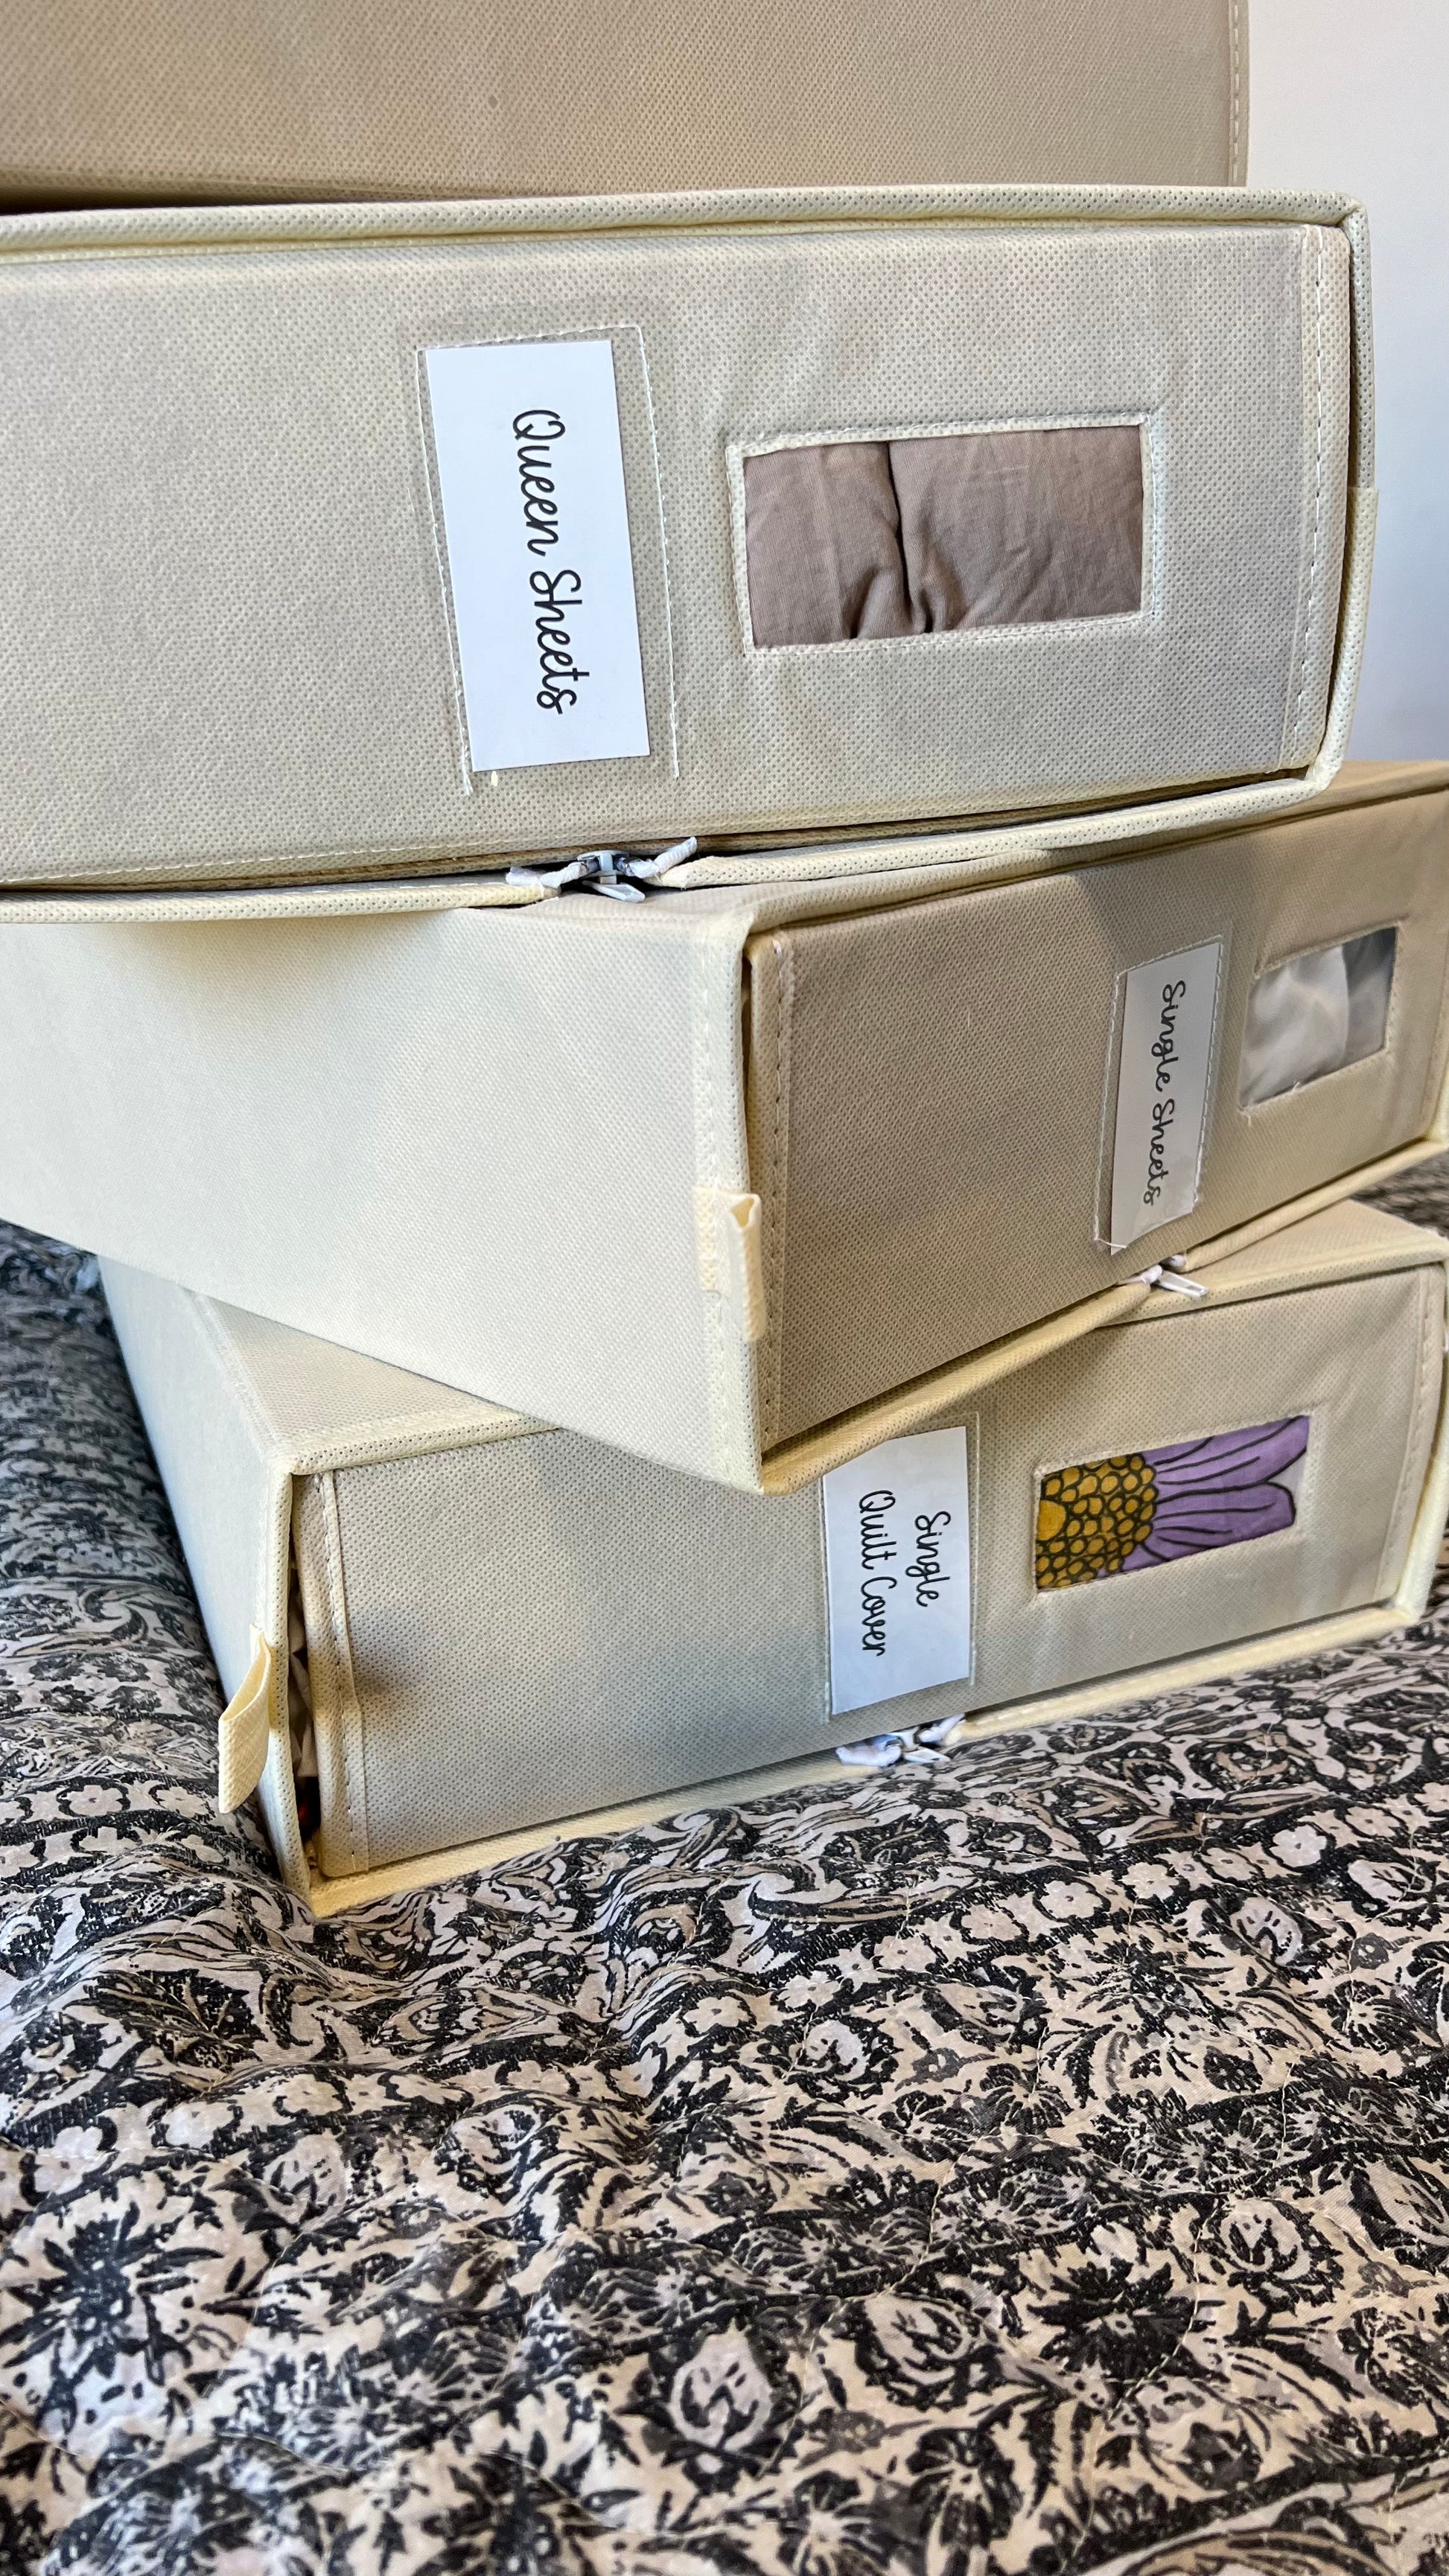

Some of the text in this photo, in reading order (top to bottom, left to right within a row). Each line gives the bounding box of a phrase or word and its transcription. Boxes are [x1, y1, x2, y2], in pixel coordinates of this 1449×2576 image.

[512, 409, 590, 715] Queen Sheets
[1142, 979, 1186, 1207] Single Sheets
[858, 1489, 898, 1657] Quilt Cover
[905, 1510, 952, 1608] Single
